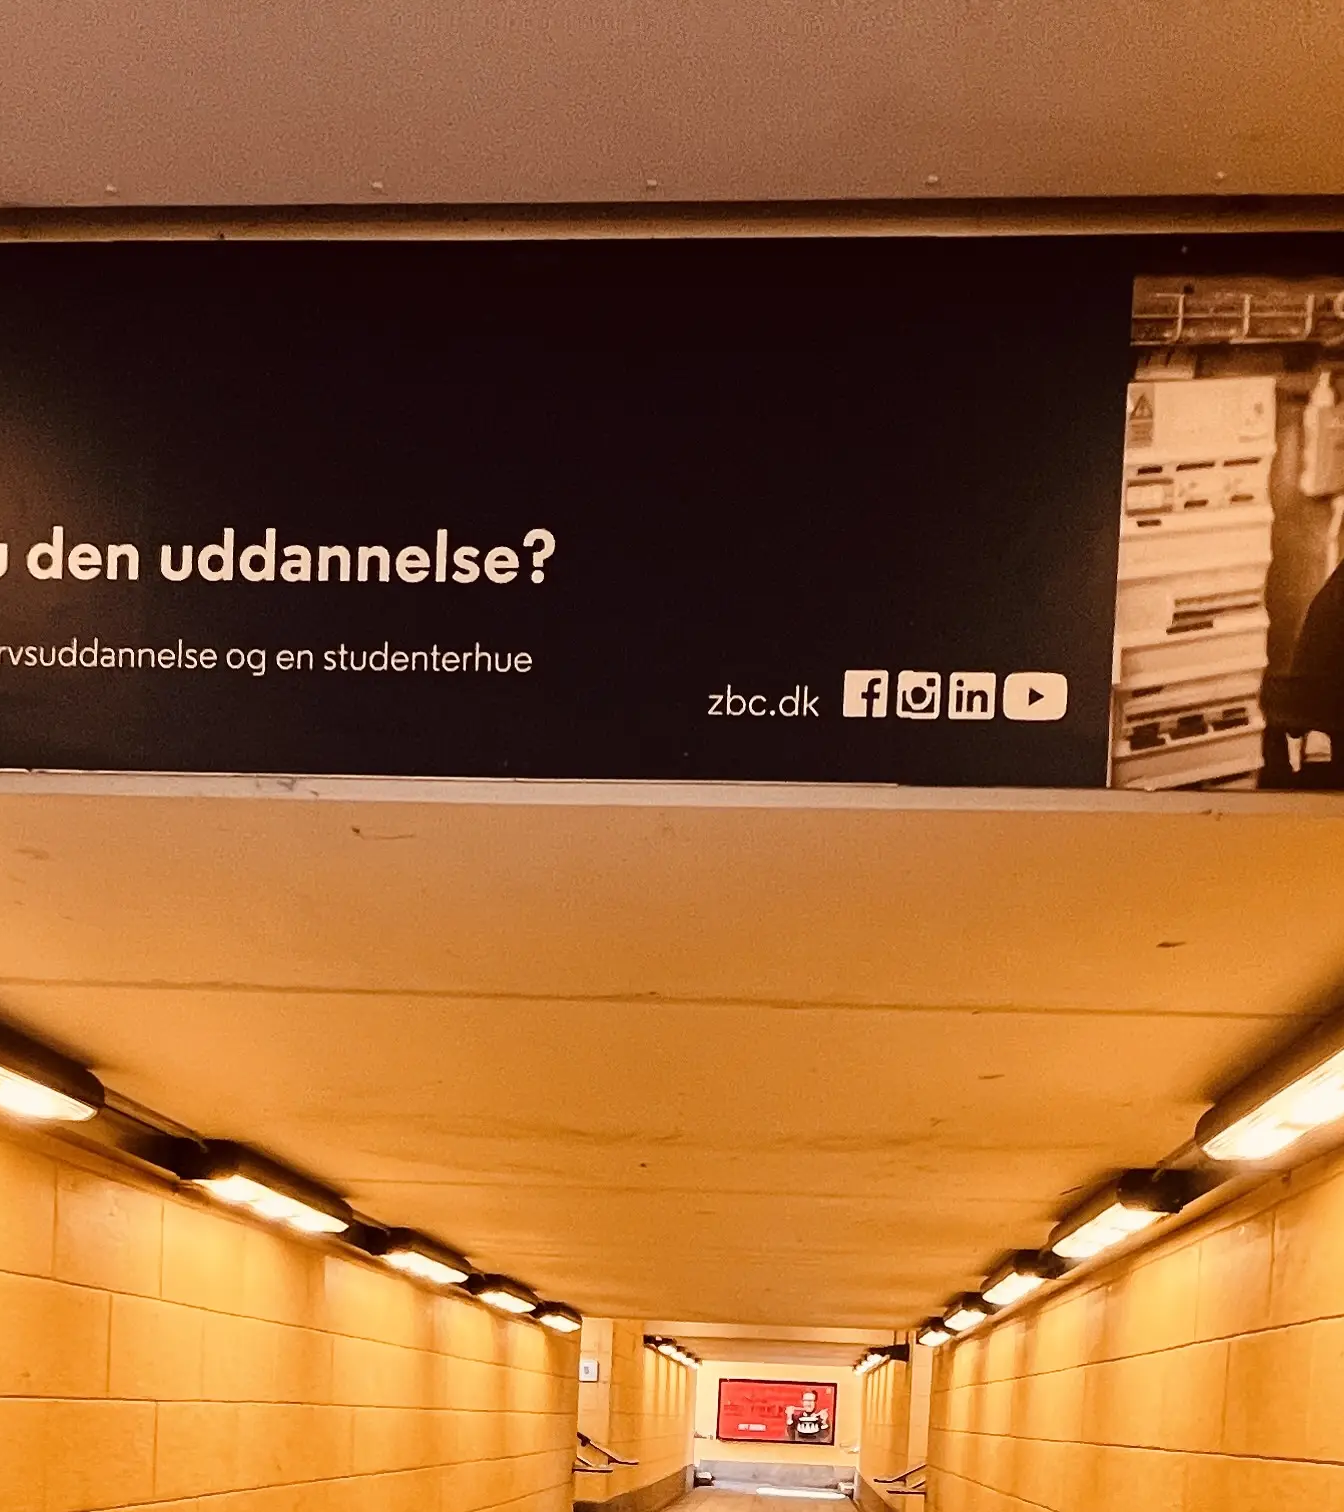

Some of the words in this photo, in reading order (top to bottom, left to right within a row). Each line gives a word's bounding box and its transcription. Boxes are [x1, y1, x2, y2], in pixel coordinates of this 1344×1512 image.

[26, 525, 139, 581] den
[160, 527, 556, 584] uddannelse?
[226, 648, 266, 677] og
[276, 649, 314, 670] en
[323, 641, 533, 673] studenterhue
[707, 683, 819, 717] zbc.dk
